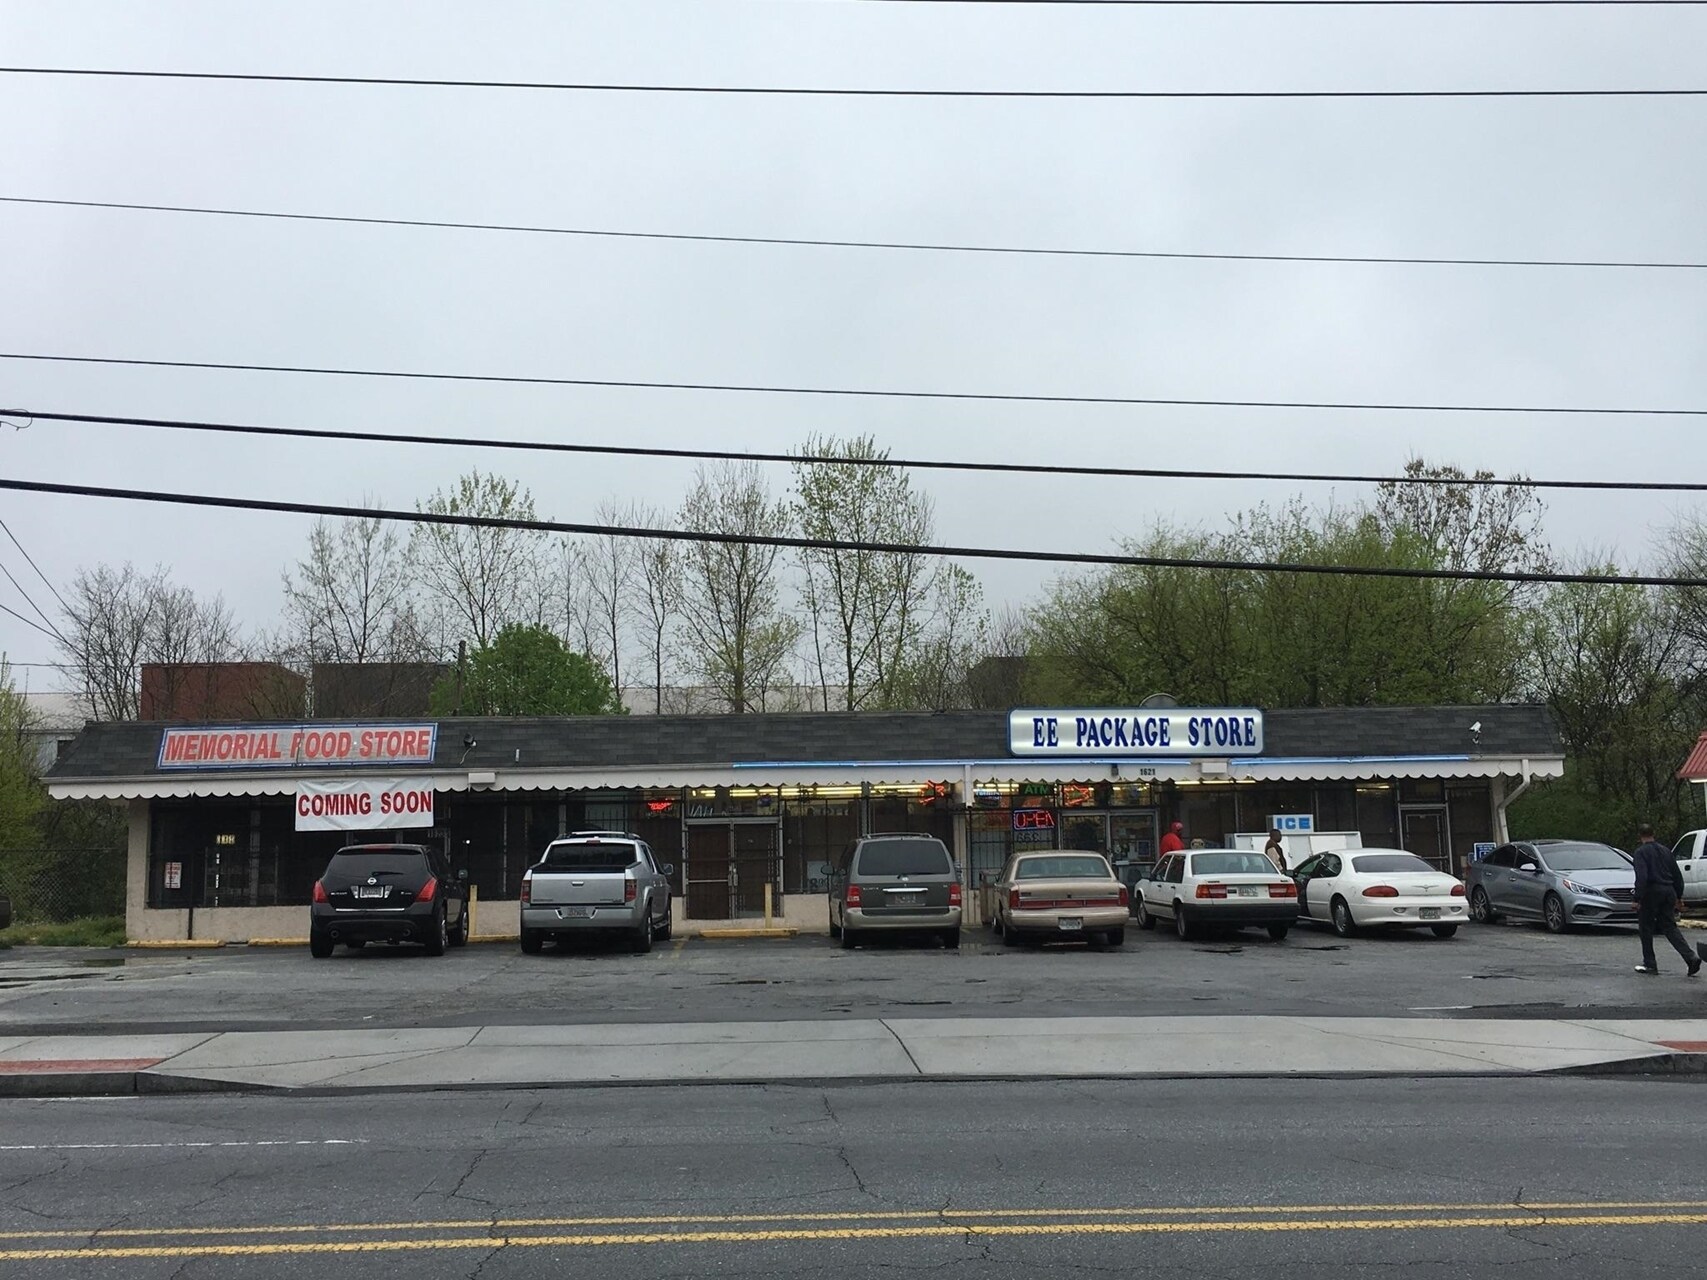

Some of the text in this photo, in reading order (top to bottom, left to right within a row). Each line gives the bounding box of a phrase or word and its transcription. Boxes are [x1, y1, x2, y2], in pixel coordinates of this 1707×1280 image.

[1032, 717, 1256, 747] EE PACKAGE STORE
[164, 730, 431, 761] MEMORIAL FOOD STORE
[1139, 768, 1156, 776] 1621
[1024, 784, 1048, 795] ATM
[298, 791, 432, 817] COMING SOON
[1015, 810, 1056, 828] OPEN
[1276, 817, 1310, 830] ICE
